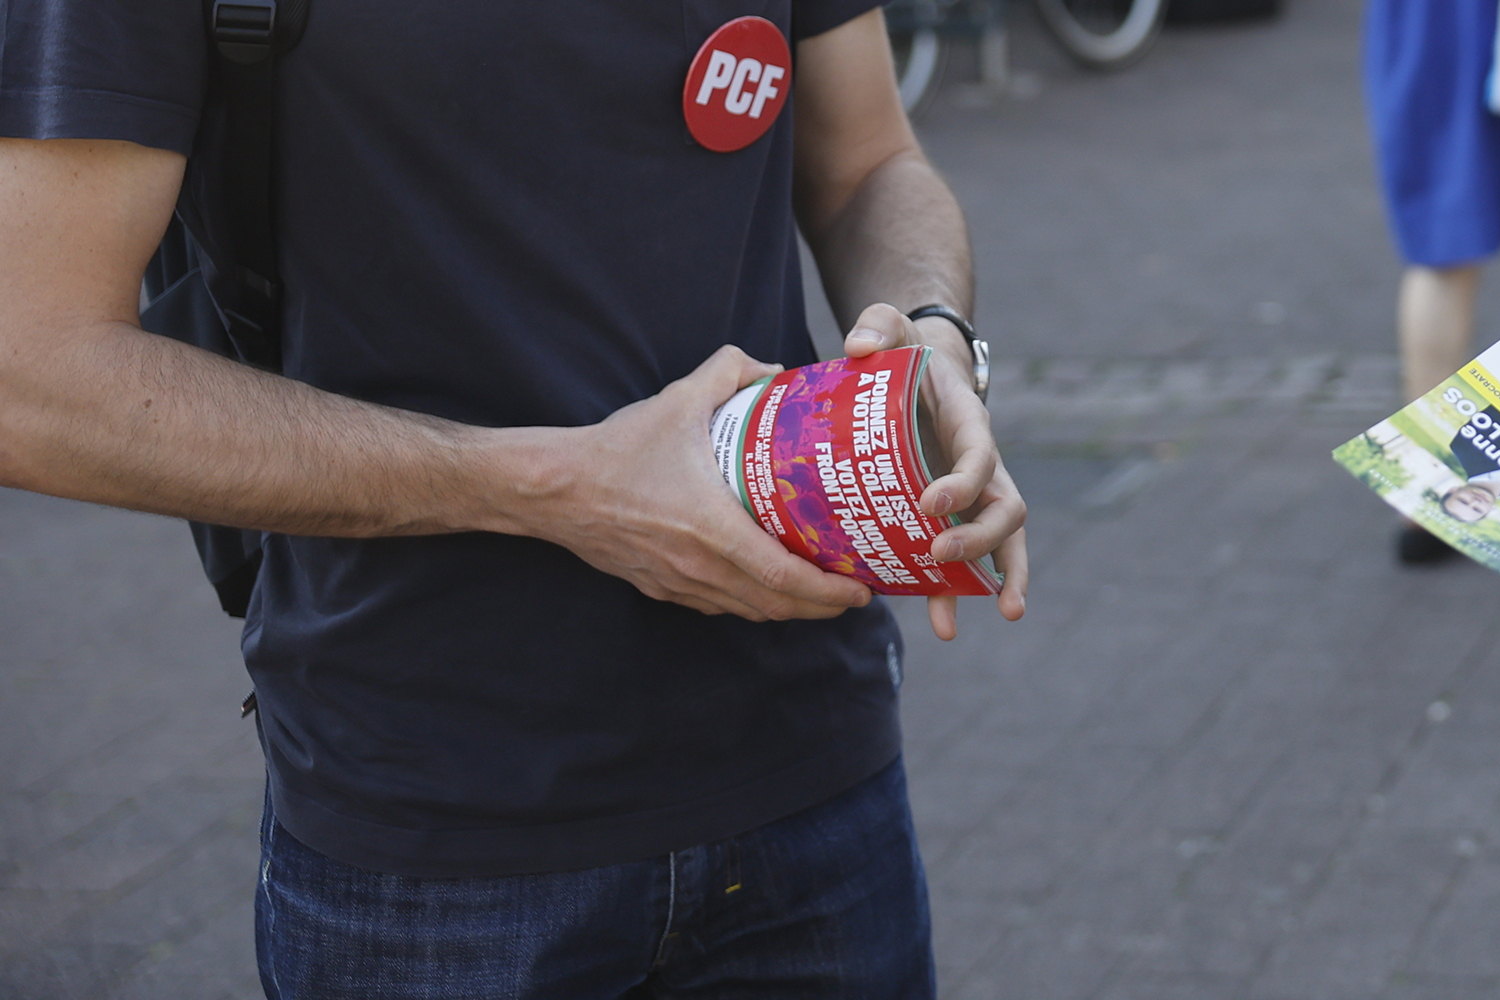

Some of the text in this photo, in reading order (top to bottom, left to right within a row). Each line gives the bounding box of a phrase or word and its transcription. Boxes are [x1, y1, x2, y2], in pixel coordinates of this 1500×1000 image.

[696, 49, 785, 119] PCF
[765, 405, 778, 437] SAUVER
[890, 420, 898, 449] ÉLECTIONS
[754, 440, 763, 462] JOUE
[762, 438, 770, 450] LA
[854, 372, 900, 527] A VOTRE COLERE
[870, 370, 928, 541] DONNEZ UNE ISSUE
[755, 463, 764, 476] UN
[746, 452, 777, 538] IL MET EN PÉRIL L'AVE
[757, 477, 770, 498] COUP
[764, 500, 774, 510] DE
[814, 442, 902, 584] FRONT POPULAIRE
[768, 511, 786, 534] POKER
[835, 458, 919, 584] VOTEZ NOUVEAU
